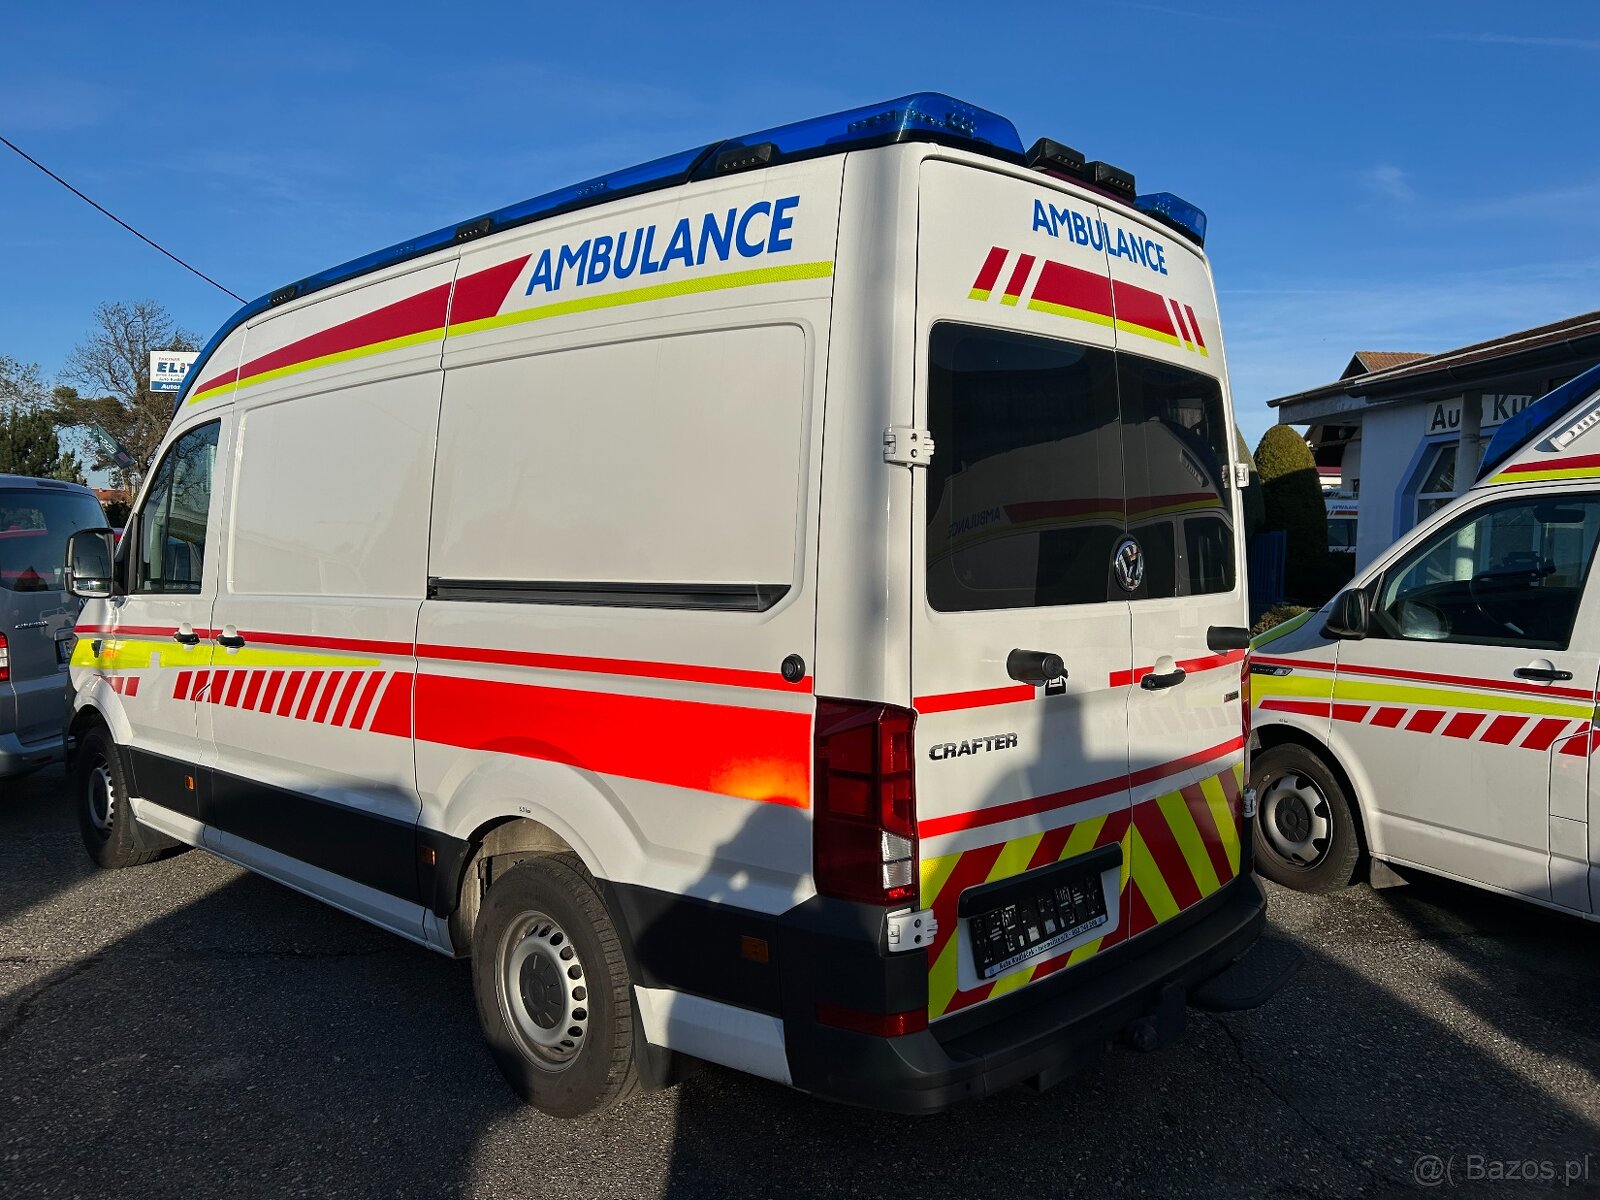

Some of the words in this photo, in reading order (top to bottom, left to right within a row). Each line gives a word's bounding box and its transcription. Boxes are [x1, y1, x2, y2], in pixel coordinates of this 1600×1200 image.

[525, 195, 800, 296] AMBULANCE
[1032, 199, 1168, 275] AMBULANCE
[929, 732, 1018, 760] CRAFTER
